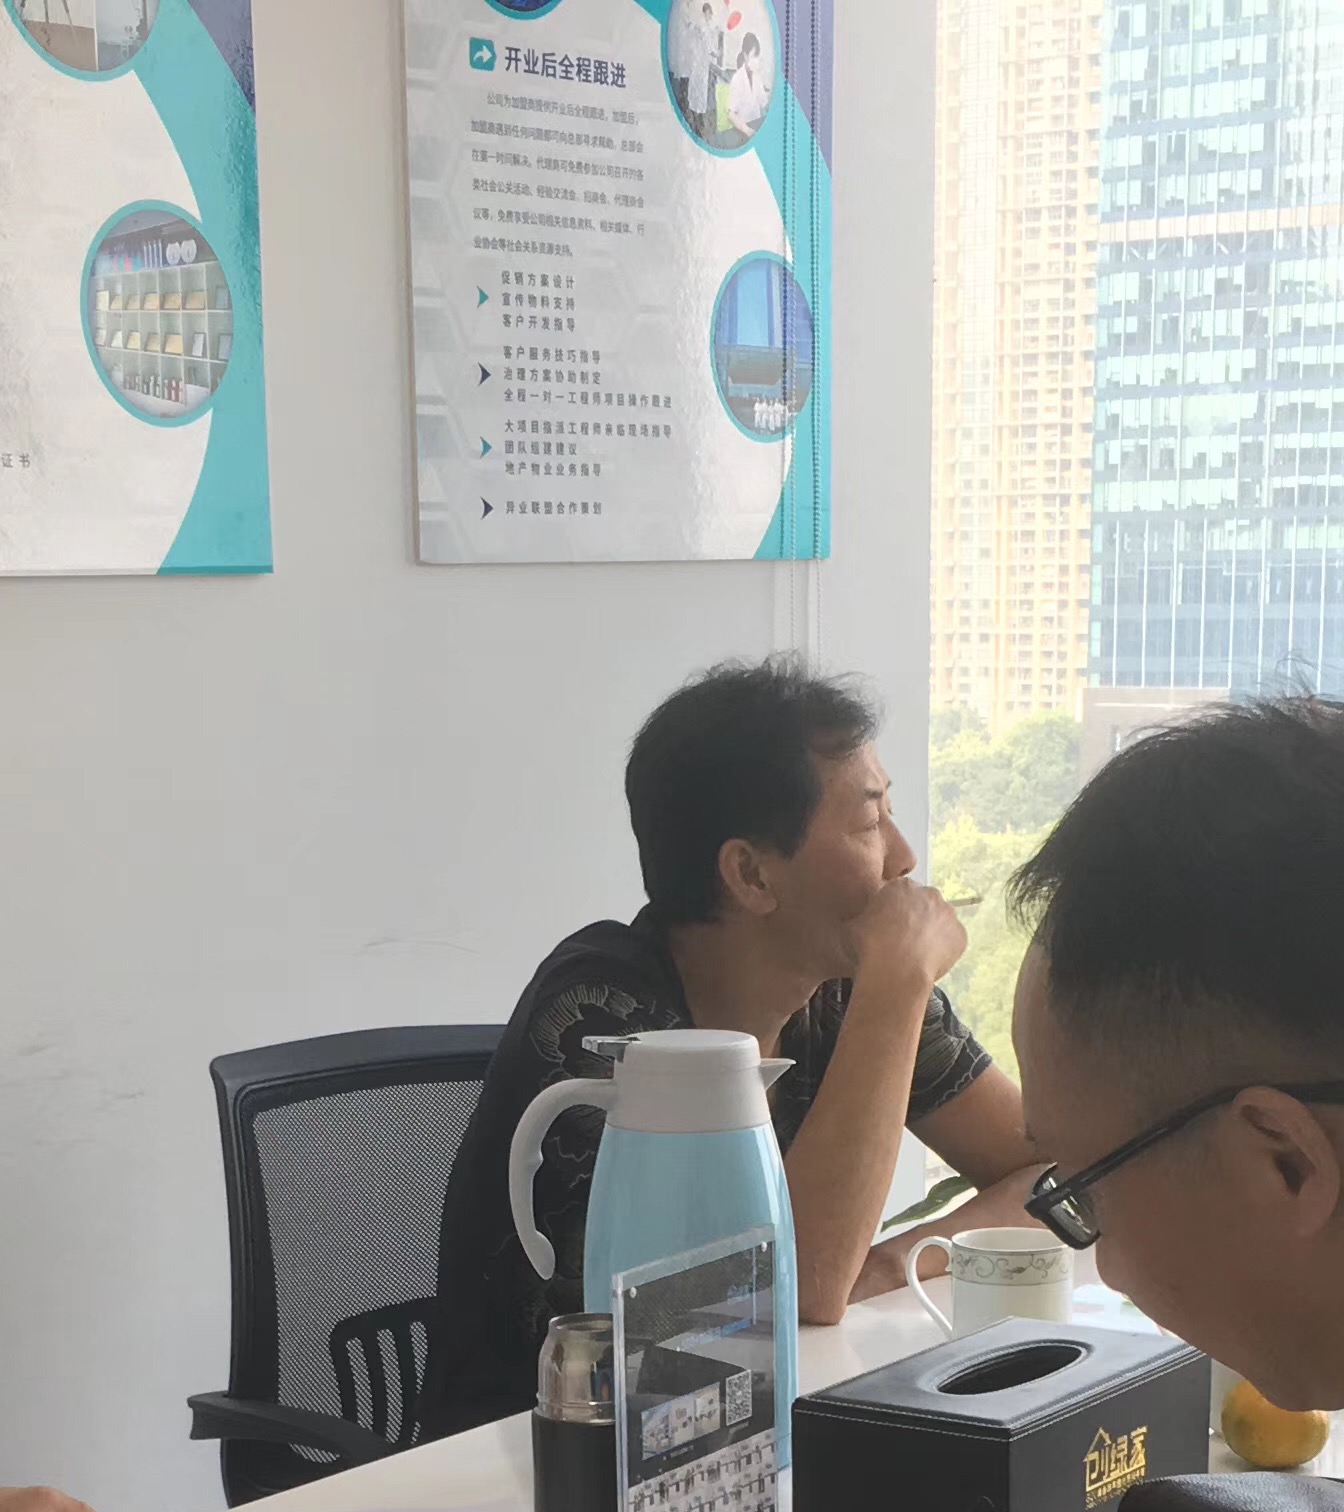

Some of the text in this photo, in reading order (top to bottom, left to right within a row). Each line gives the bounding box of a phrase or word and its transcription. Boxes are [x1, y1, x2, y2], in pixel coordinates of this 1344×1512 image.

[505, 46, 626, 88] 开业后全程跟进
